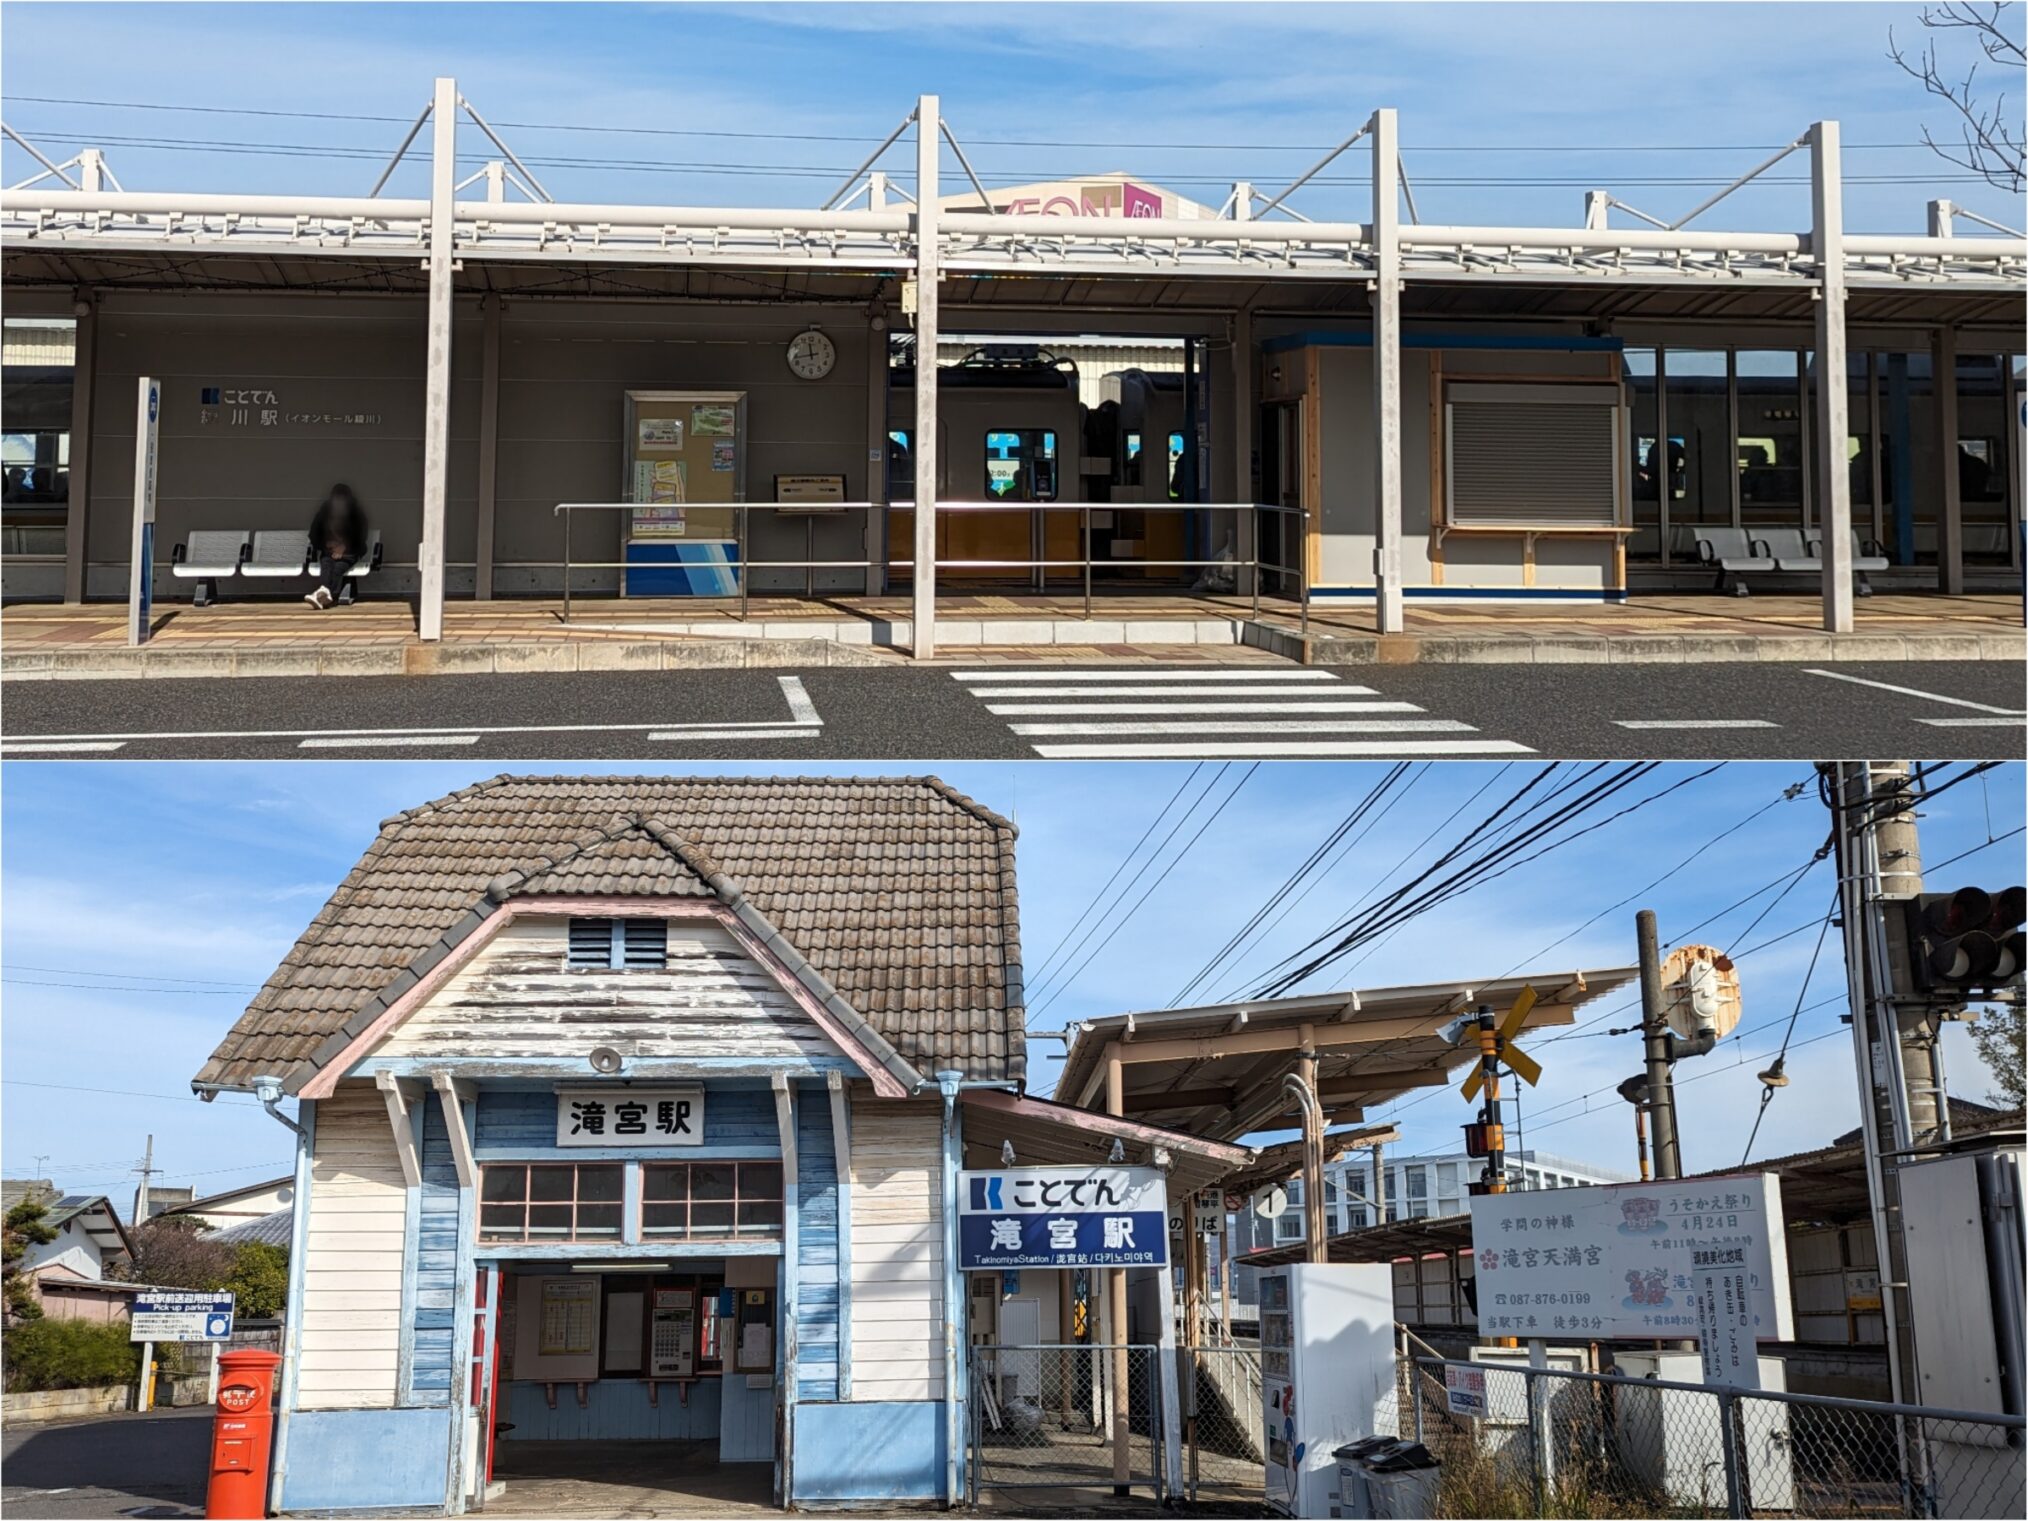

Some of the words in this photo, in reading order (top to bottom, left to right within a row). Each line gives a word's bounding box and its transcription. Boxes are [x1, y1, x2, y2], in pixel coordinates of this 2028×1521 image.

[224, 390, 279, 405] ことでん
[570, 1100, 692, 1135] 滝宮駅
[1013, 1179, 1121, 1207] ことでん
[1262, 1190, 1273, 1213] 1
[1669, 1193, 1752, 1212] うそかえ祭り
[1500, 1214, 1575, 1232] 学問の神様
[1681, 1214, 1738, 1231] 4月24日
[990, 1216, 1136, 1251] 滝宮駅
[1095, 1251, 1153, 1263] 다키노미야역
[1502, 1244, 1603, 1268] 滝宮天満宮
[153, 1304, 182, 1312] Pick-up
[185, 1304, 213, 1312] parking
[1487, 1314, 1538, 1329] 当駅下車
[1553, 1314, 1603, 1330] 徒歩3分
